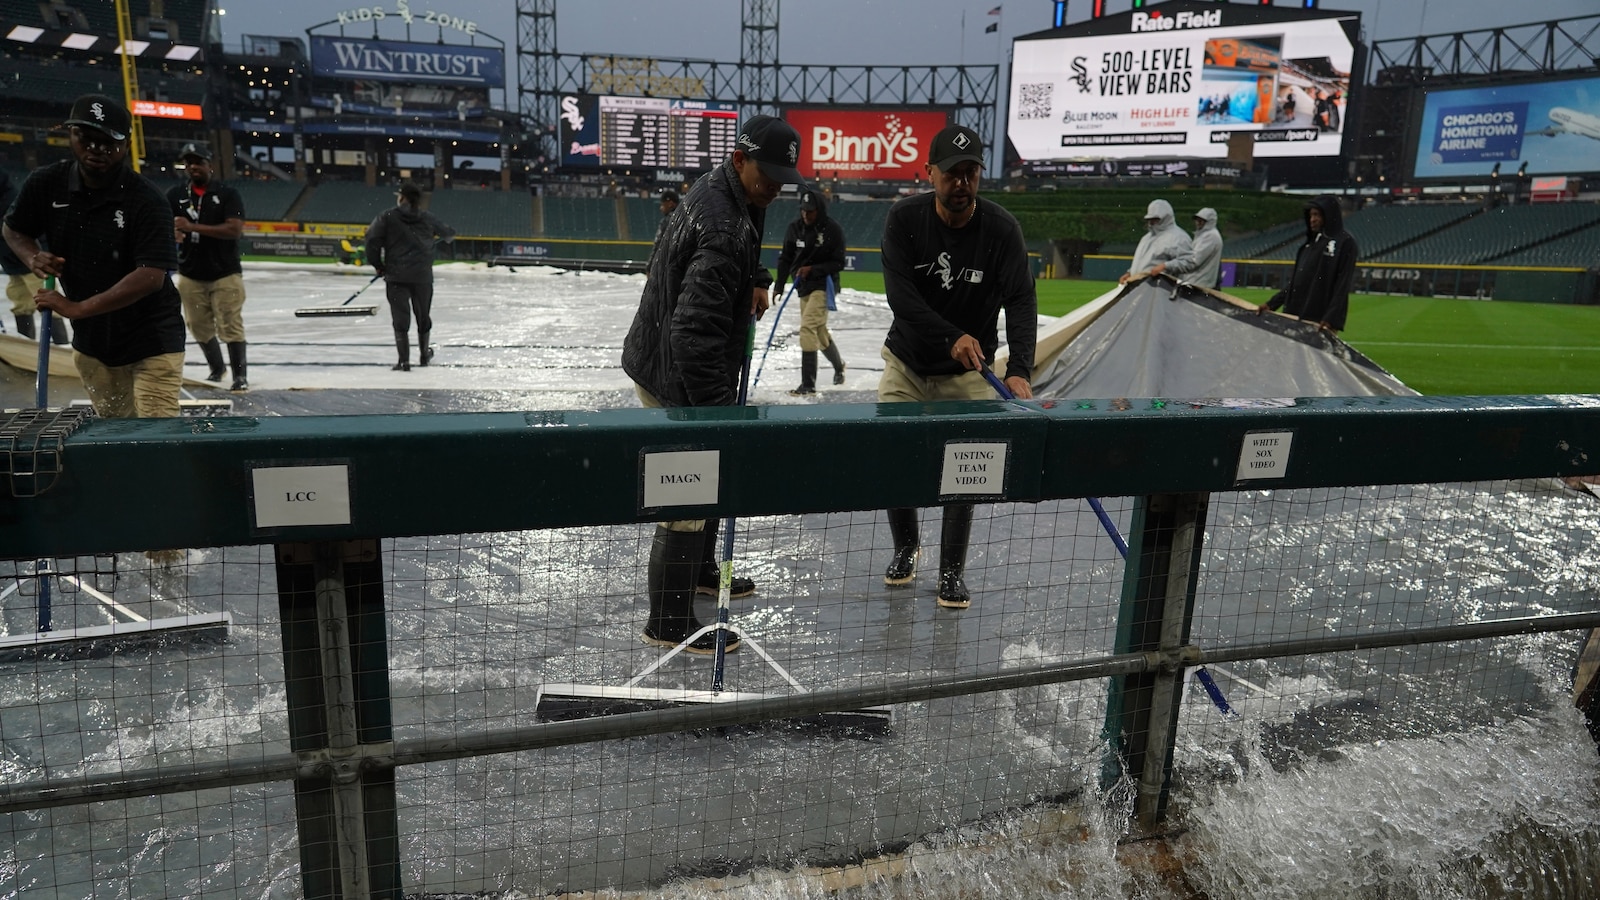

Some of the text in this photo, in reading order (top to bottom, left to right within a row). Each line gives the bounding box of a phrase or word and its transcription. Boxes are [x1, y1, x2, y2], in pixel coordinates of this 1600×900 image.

[337, 6, 386, 25] KIDS
[424, 10, 478, 35] ZONE
[1131, 9, 1222, 32] Rate Field
[332, 42, 485, 76] WINTRUST
[591, 56, 659, 71] CAESARS
[1101, 47, 1192, 73] 500-LEVEL
[591, 73, 705, 97] SPORTSBOOK
[1099, 71, 1192, 96] VIEW BARS
[1062, 110, 1118, 124] BLUE MOON
[1130, 107, 1190, 119] HIGH LIFE
[1443, 111, 1515, 127] CHICAGO'S
[1441, 124, 1518, 139] HOMETOWN
[1439, 138, 1487, 151] AIRLINE
[813, 162, 875, 171] BEVERAGE DEPOT
[1205, 166, 1220, 175] FAN
[656, 171, 685, 182] Modelo
[1253, 438, 1279, 446] WHITE
[954, 450, 994, 460] VISTING
[1255, 449, 1273, 458] SOX
[957, 463, 987, 472] TEAM
[1250, 460, 1276, 469] VIDEO
[659, 472, 701, 485] IMAGN
[955, 476, 987, 485] VIDEO
[285, 490, 317, 502] LCC
